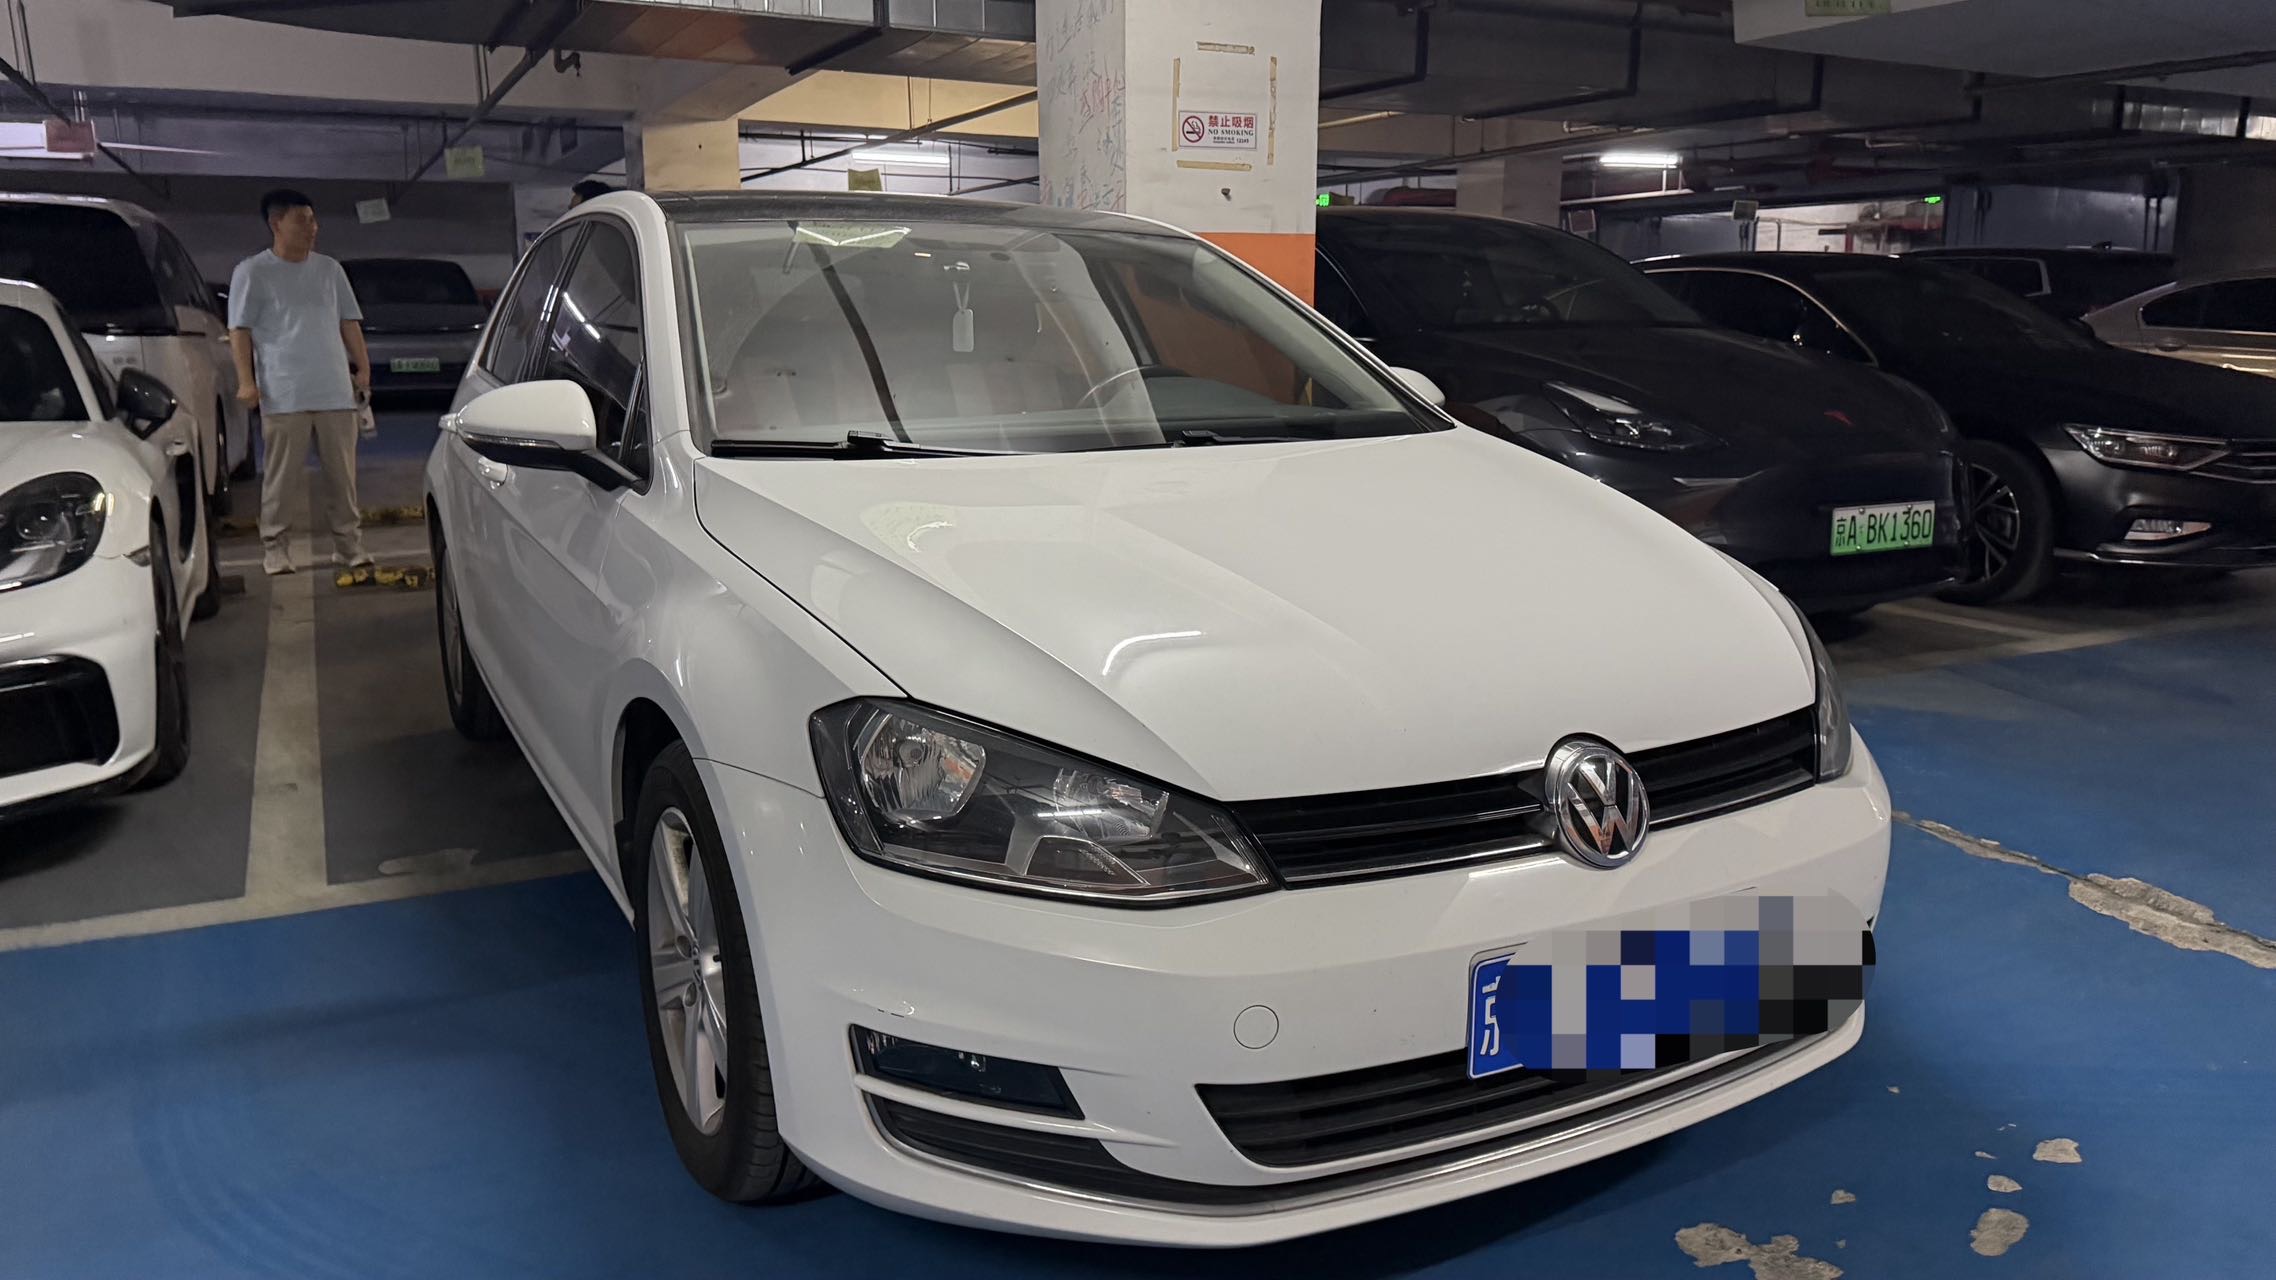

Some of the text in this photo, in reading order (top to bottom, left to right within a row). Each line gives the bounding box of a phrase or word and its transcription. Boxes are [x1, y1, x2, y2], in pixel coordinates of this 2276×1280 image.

[1208, 115, 1254, 128] 禁止吸烟
[1866, 509, 1932, 544] BK1360
